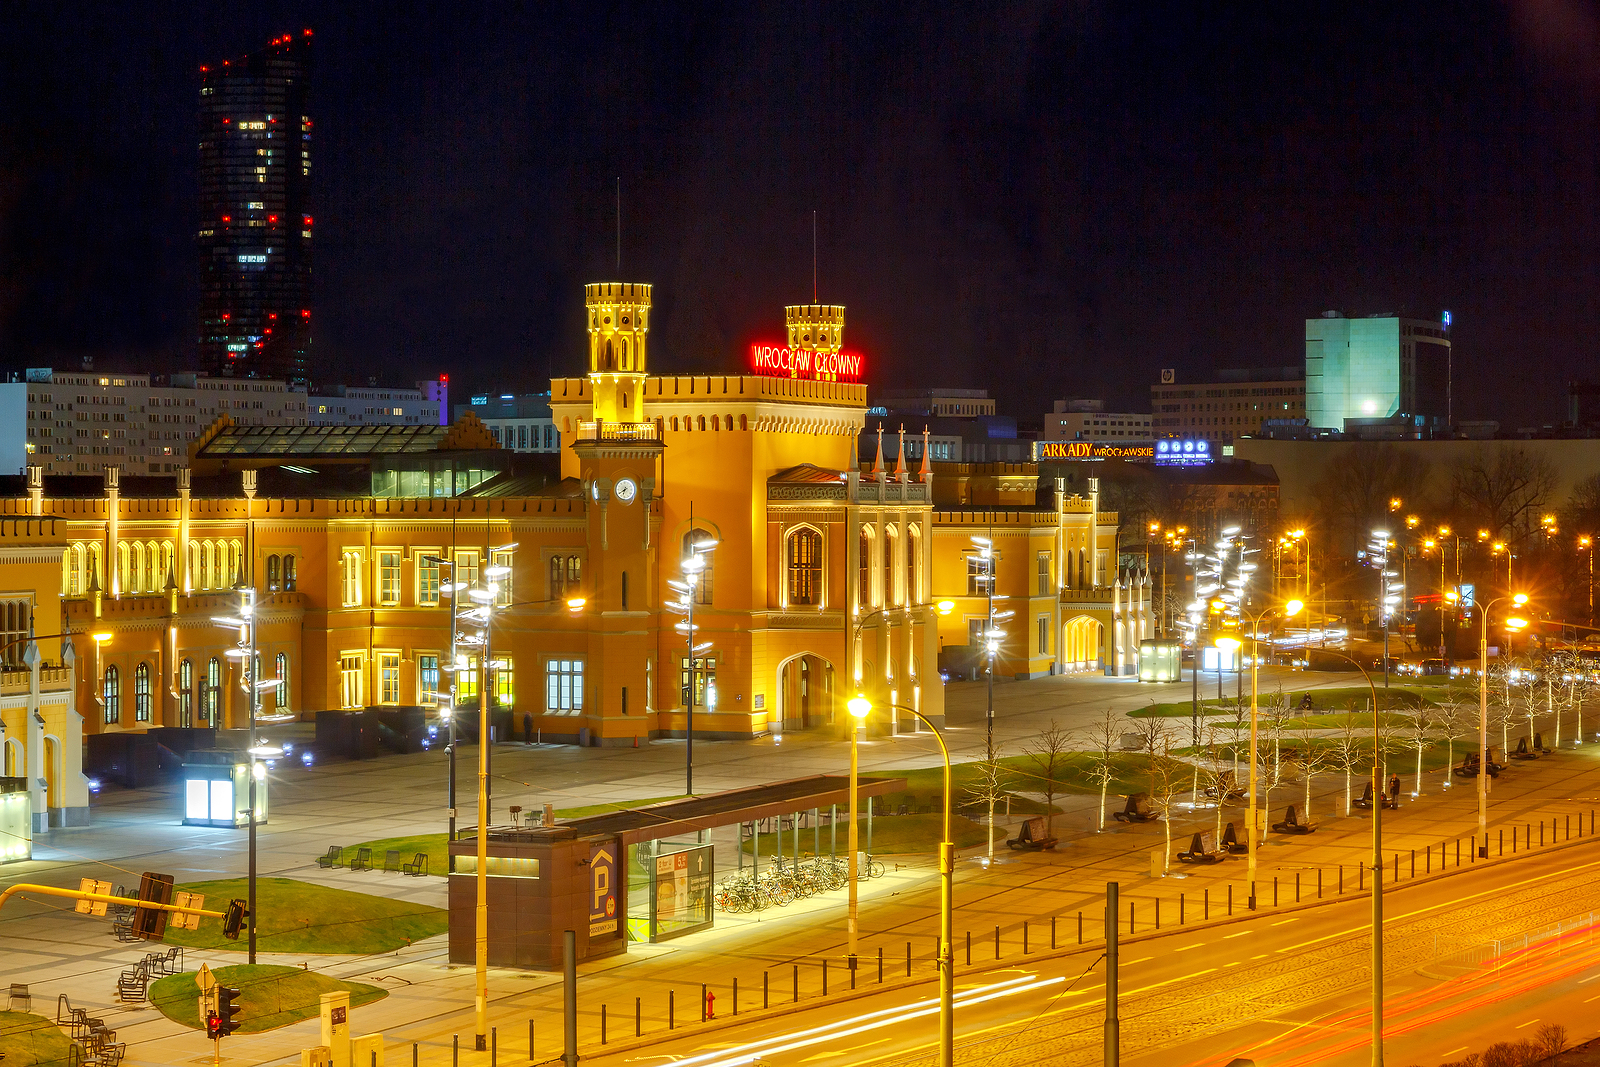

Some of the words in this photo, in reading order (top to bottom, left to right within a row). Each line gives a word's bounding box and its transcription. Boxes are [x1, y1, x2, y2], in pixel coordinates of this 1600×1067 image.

[754, 346, 810, 371] WROCŁAW
[1042, 443, 1093, 457] ARKADY
[1093, 447, 1154, 457] WROCŁAWSKIE
[594, 865, 609, 909] P
